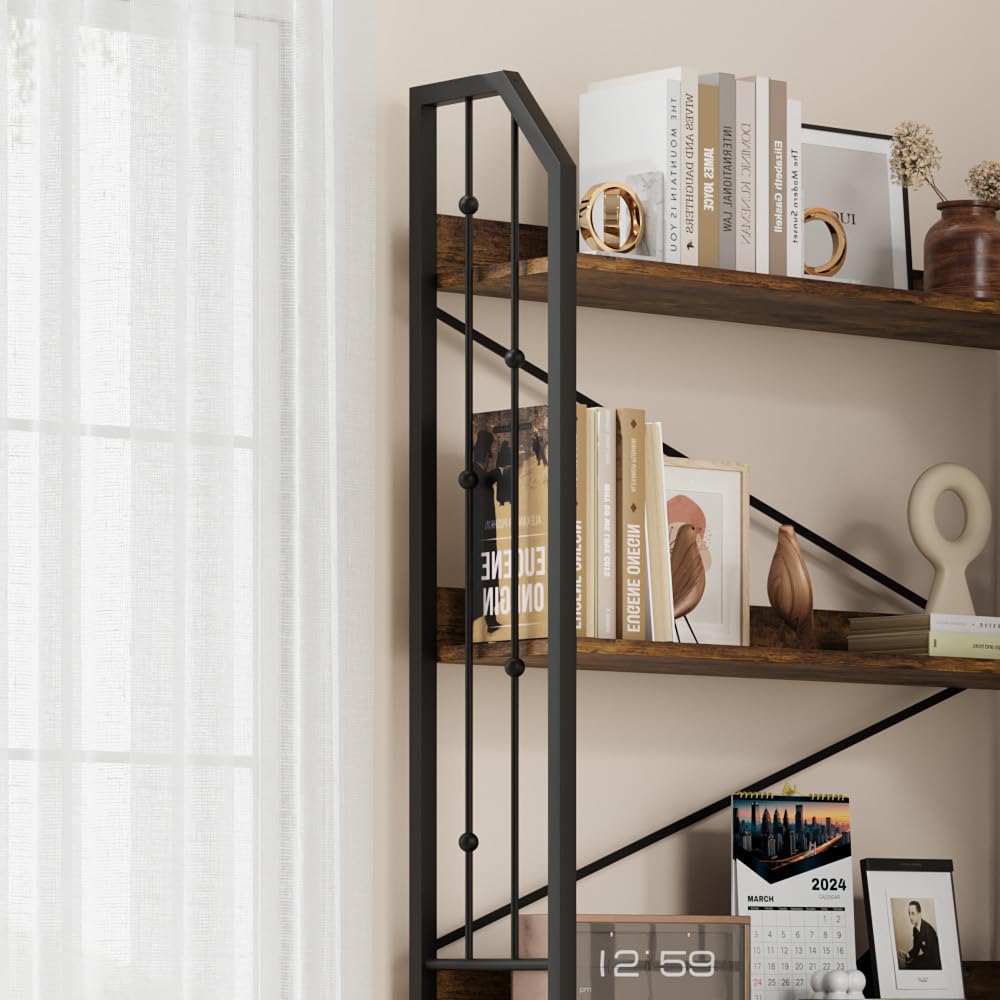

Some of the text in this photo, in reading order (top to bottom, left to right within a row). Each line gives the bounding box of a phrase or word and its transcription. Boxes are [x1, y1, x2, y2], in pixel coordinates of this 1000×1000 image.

[811, 877, 847, 891] 2024
[768, 946, 774, 954] 11
[781, 946, 788, 954] 12
[795, 946, 802, 954] 13
[808, 946, 816, 954] 14
[823, 946, 830, 954] 15
[836, 946, 844, 954] 16
[754, 962, 844, 970] 17 18 19 20 21 22 23
[768, 978, 776, 986] 25
[781, 978, 790, 986] 26
[795, 978, 804, 986] 27
